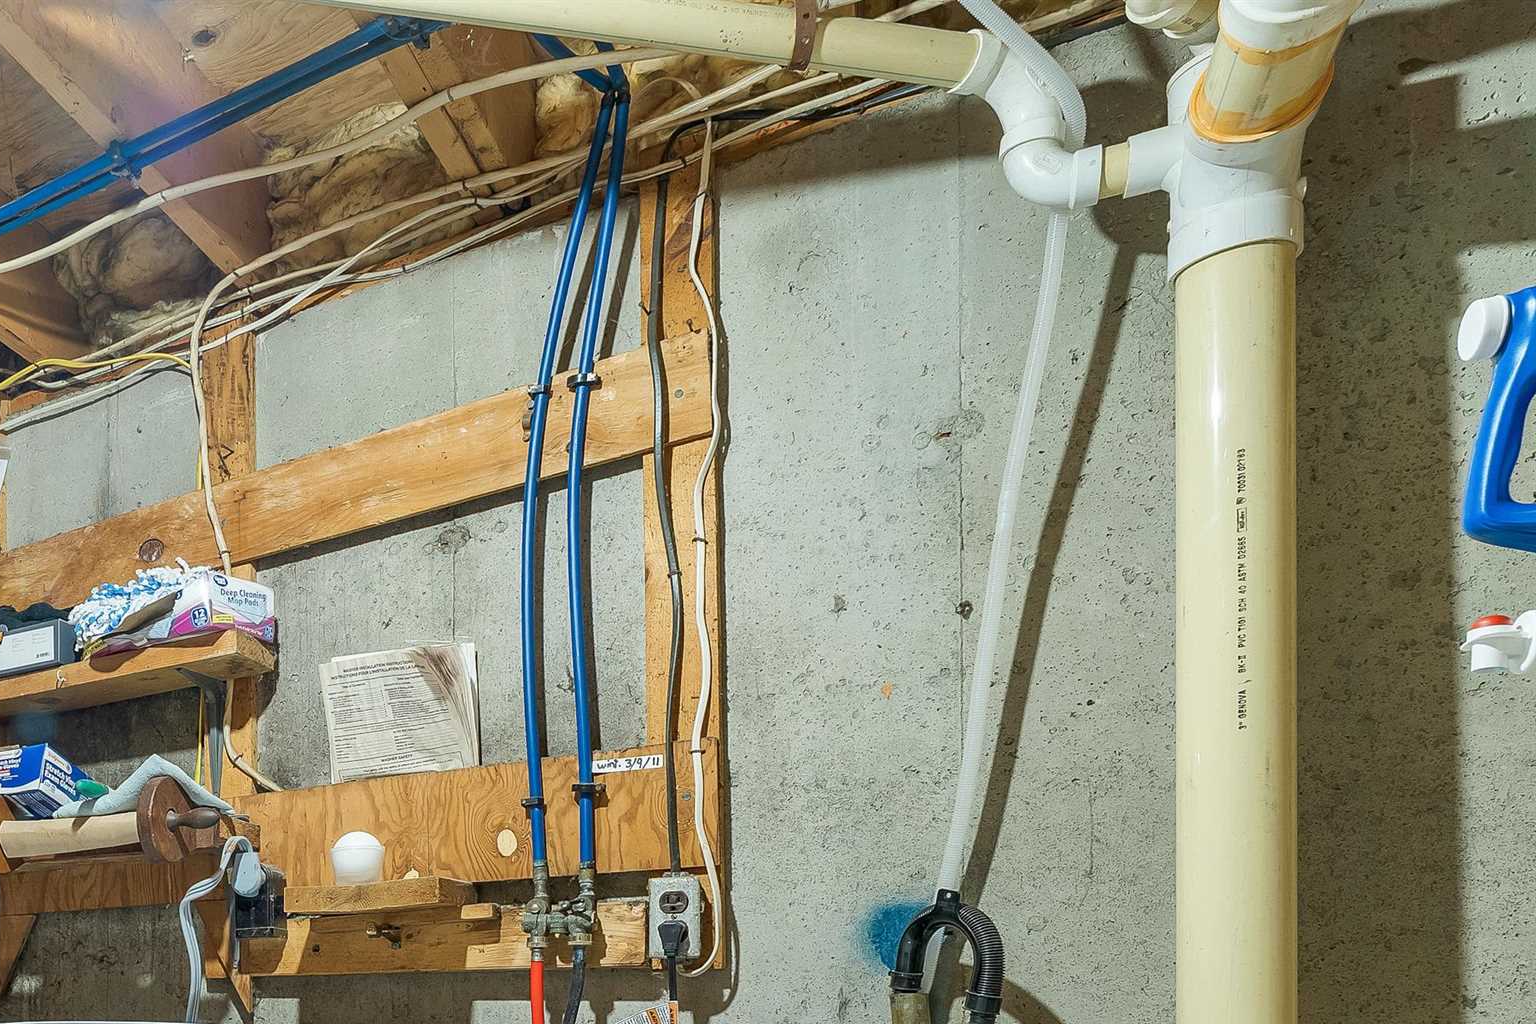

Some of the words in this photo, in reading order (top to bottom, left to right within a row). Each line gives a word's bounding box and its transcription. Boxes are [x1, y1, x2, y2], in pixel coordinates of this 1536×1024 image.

[1238, 563, 1246, 582] ASTM
[220, 588, 238, 598] Deep
[239, 589, 266, 602] Cleaning
[1238, 584, 1246, 595] 40
[227, 596, 243, 607] Mop
[244, 597, 259, 606] Pads
[1238, 597, 1246, 613] SCH
[193, 609, 205, 620] 12
[1238, 633, 1246, 648] PVC
[1238, 689, 1246, 719] GENOVA
[625, 756, 660, 769] 3/9/11
[46, 762, 68, 781] Stretch
[44, 769, 59, 784] Exam
[59, 779, 77, 796] Gloves
